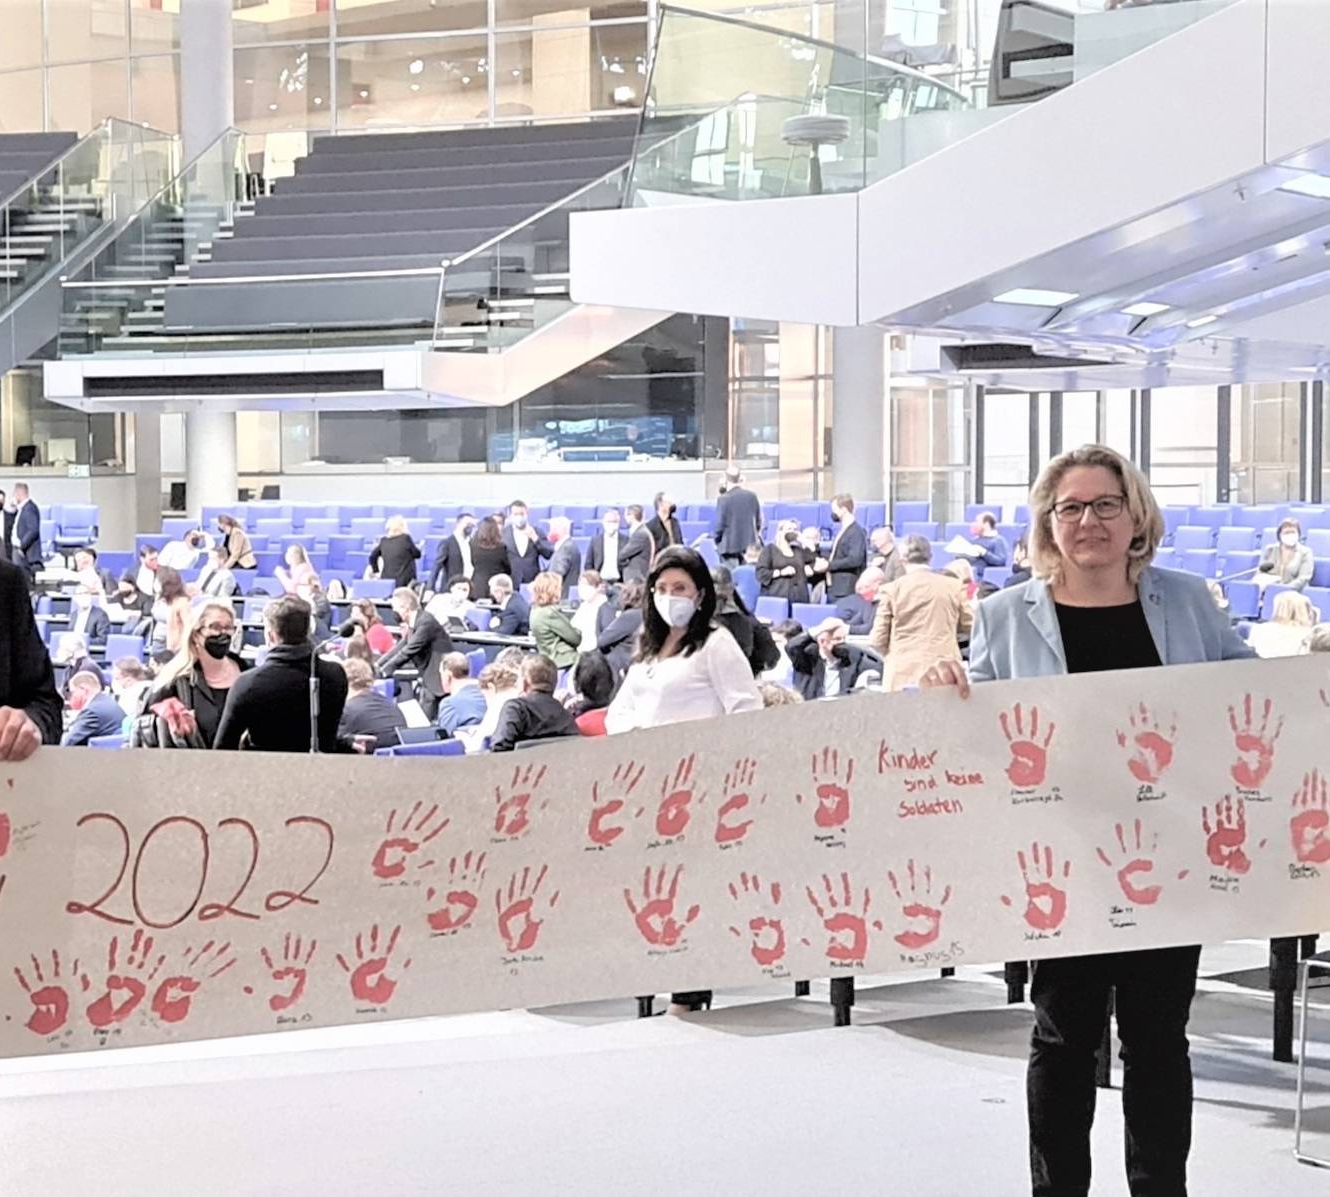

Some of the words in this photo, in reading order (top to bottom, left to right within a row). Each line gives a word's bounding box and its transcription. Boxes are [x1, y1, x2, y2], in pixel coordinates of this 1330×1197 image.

[878, 738, 938, 774] Kinder
[903, 775, 938, 793] sind
[945, 769, 985, 786] keine
[897, 799, 964, 818] Soldaten
[65, 811, 335, 930] 2022
